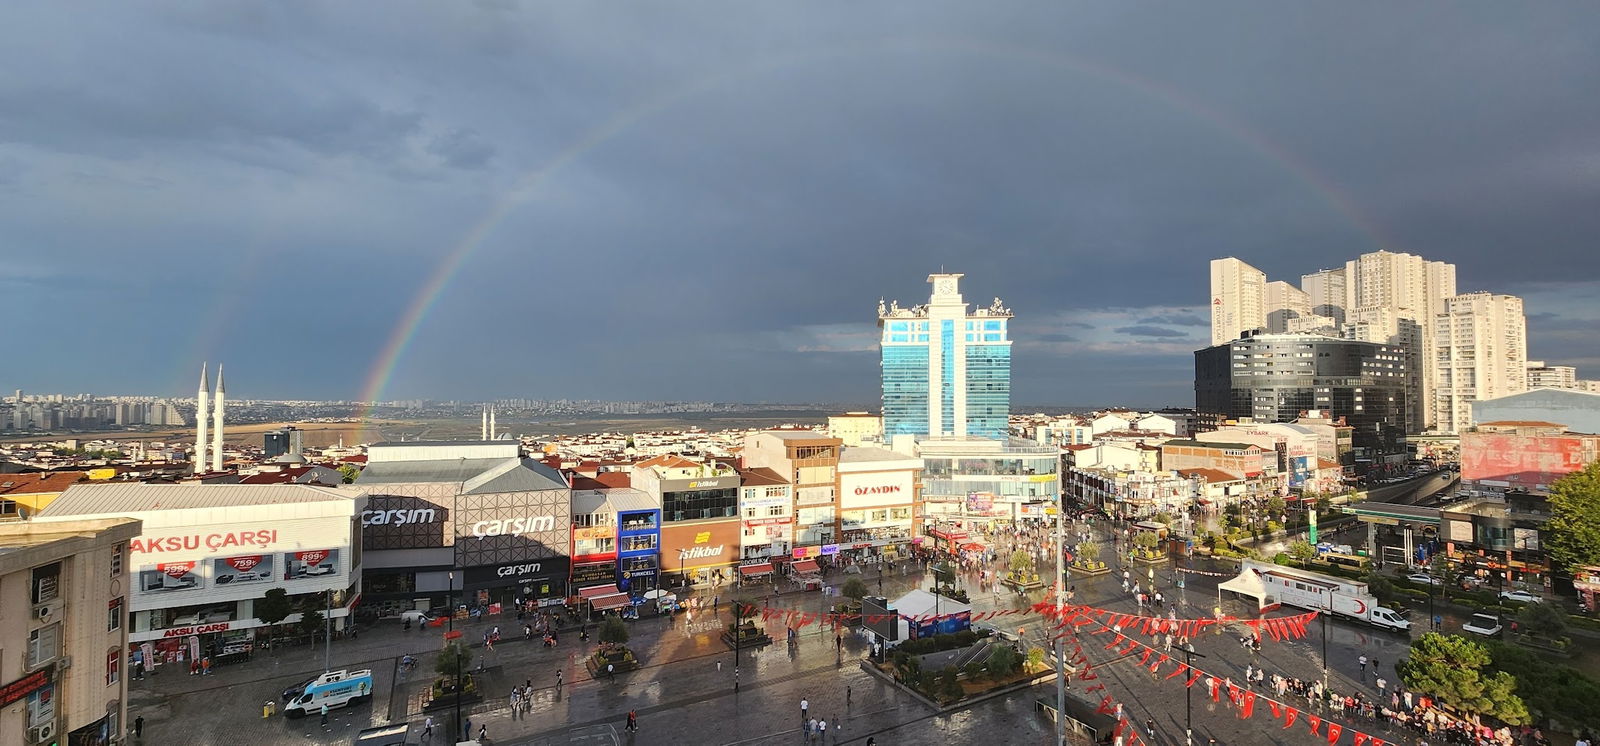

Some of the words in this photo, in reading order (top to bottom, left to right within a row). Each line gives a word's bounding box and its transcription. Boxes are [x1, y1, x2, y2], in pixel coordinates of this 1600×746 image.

[696, 480, 719, 488] istikbal
[854, 485, 900, 496] ÖZAYDIN
[362, 508, 435, 528] çarşım
[472, 515, 555, 541] çarşım
[130, 534, 200, 554] AKSU
[205, 529, 278, 553] ÇARŞI
[678, 544, 724, 560] istikbal
[497, 562, 541, 578] çarşım
[163, 627, 194, 638] AKSU
[196, 622, 230, 634] ÇARŞI
